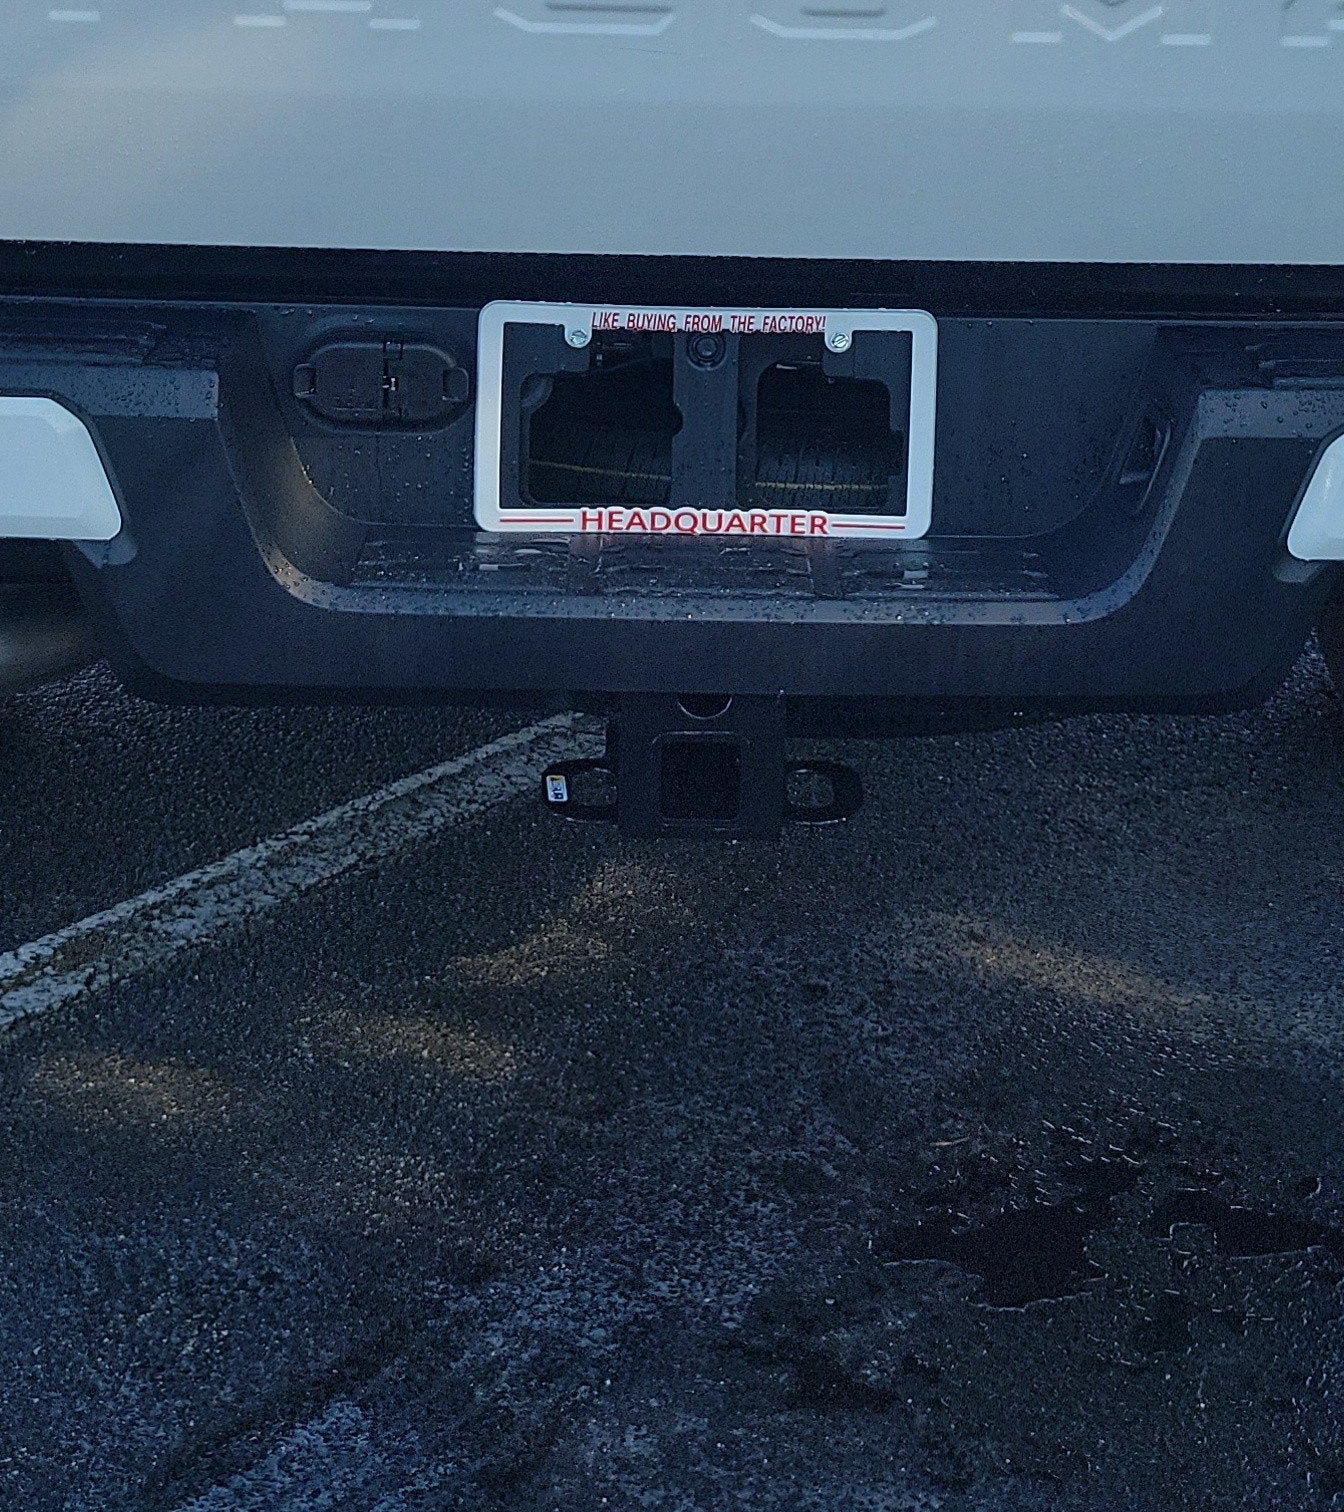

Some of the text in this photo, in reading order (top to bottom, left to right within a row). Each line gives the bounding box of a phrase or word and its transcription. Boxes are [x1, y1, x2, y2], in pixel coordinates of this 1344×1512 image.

[592, 312, 826, 334] LIKE BUYING FROM THE FACTORY!
[580, 510, 828, 536] HEADQUARTER
